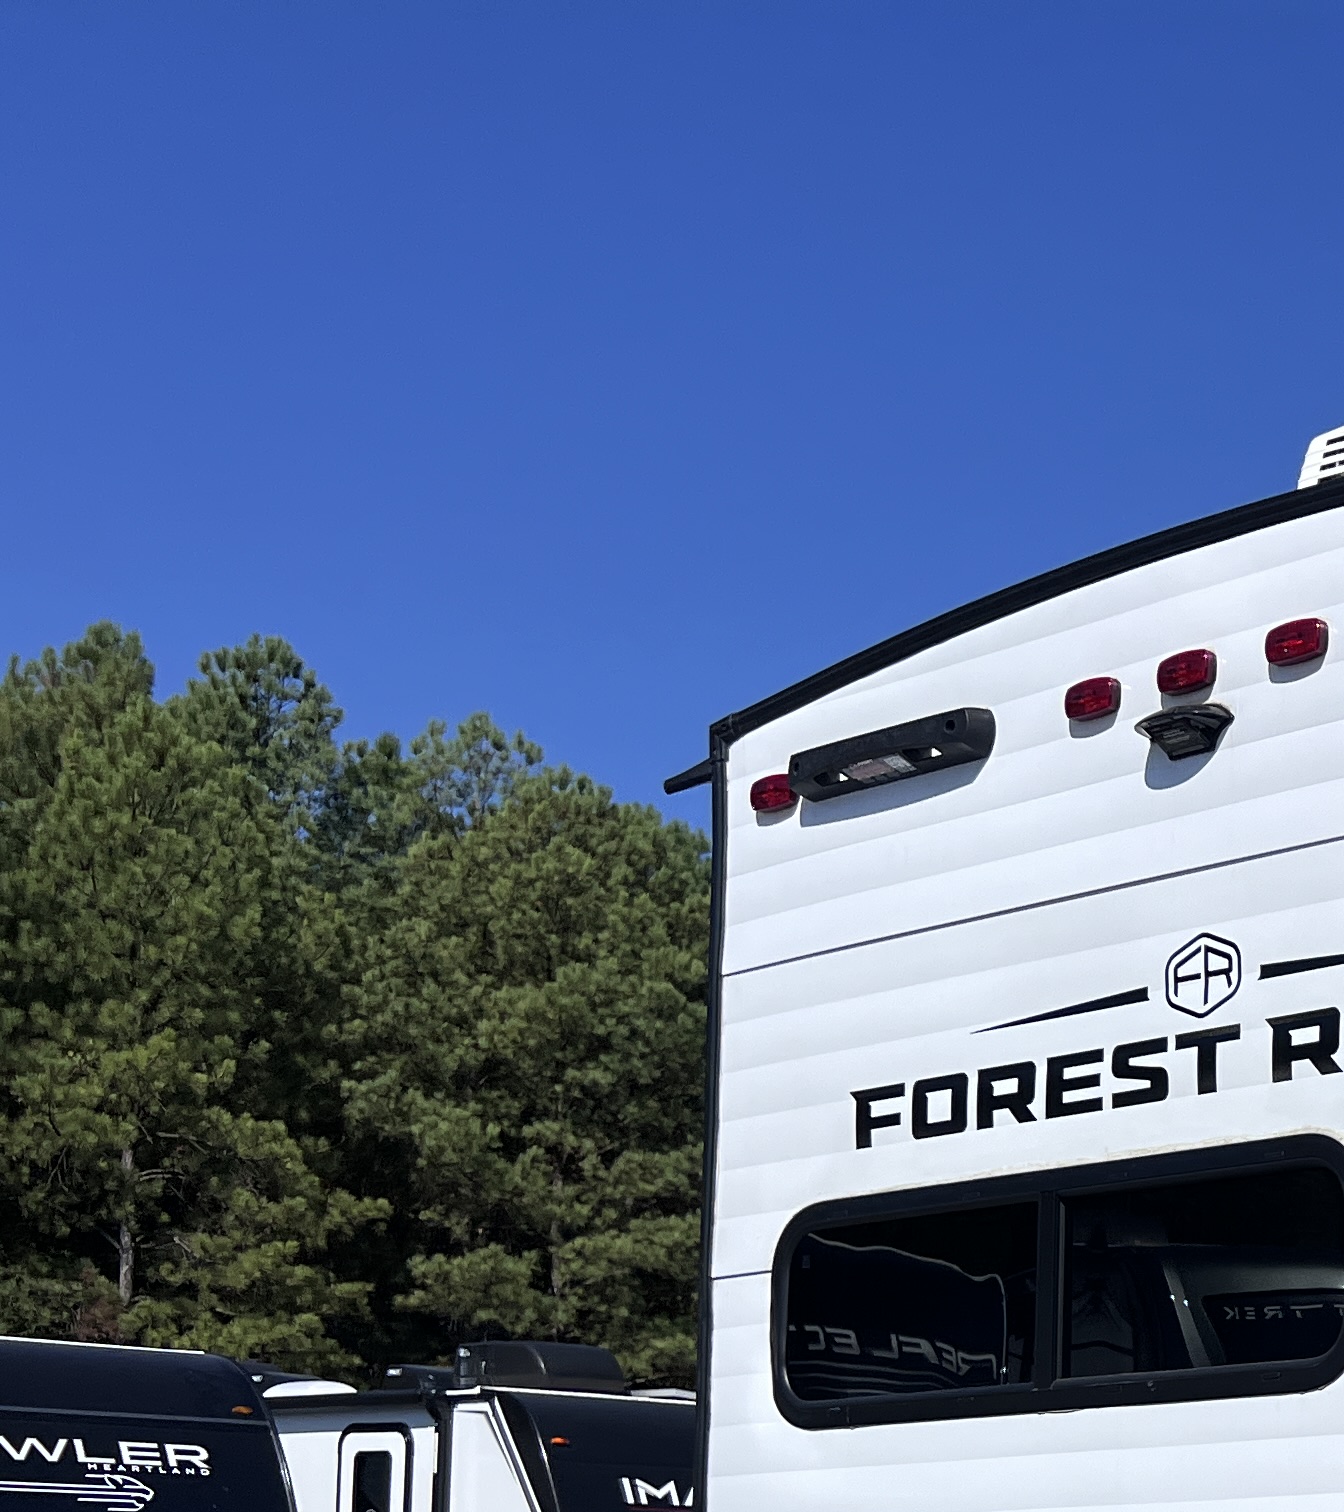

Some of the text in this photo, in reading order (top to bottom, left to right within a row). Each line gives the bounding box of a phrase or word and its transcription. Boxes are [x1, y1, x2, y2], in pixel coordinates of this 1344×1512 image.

[850, 1023, 1241, 1150] FOREST
[0, 1435, 212, 1469] WLER
[87, 1462, 211, 1477] HEARTLAND
